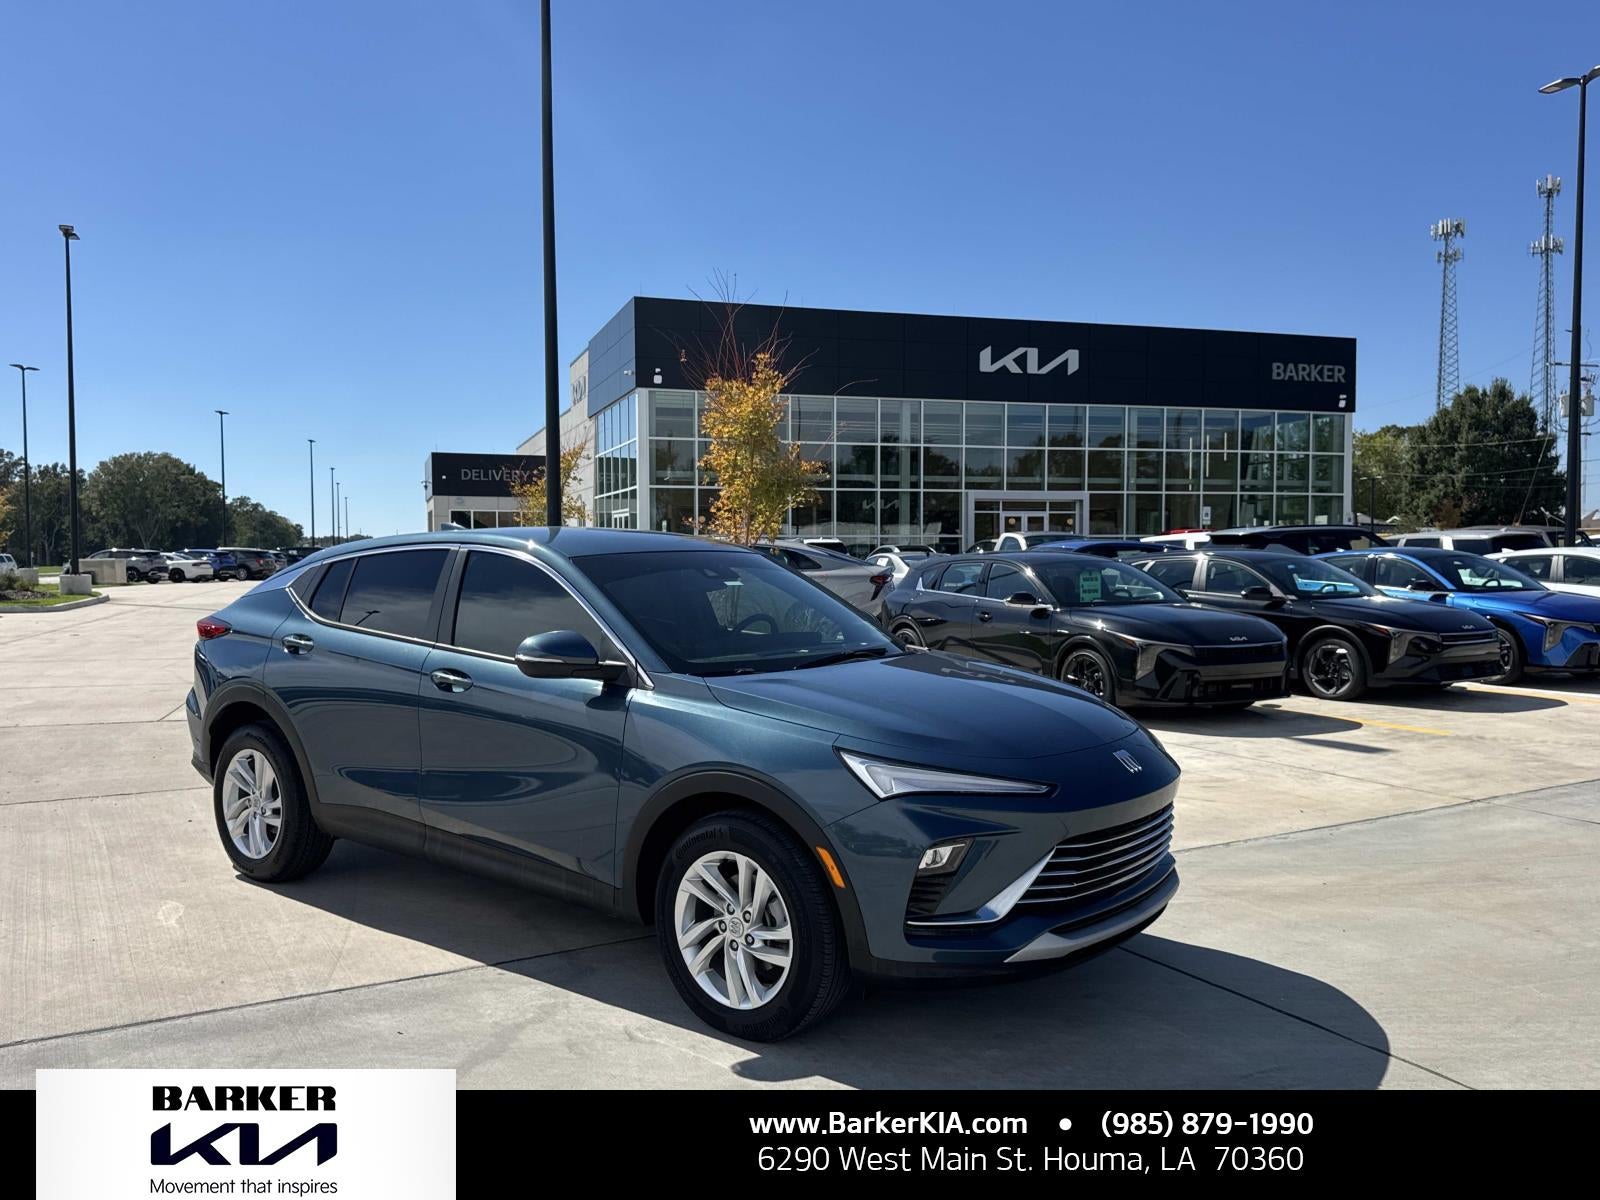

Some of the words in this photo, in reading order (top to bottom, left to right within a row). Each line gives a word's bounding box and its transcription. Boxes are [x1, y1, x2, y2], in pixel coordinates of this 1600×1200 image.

[979, 345, 1080, 375] KIA
[1272, 362, 1346, 383] BARKER
[460, 468, 531, 482] DELIVERY
